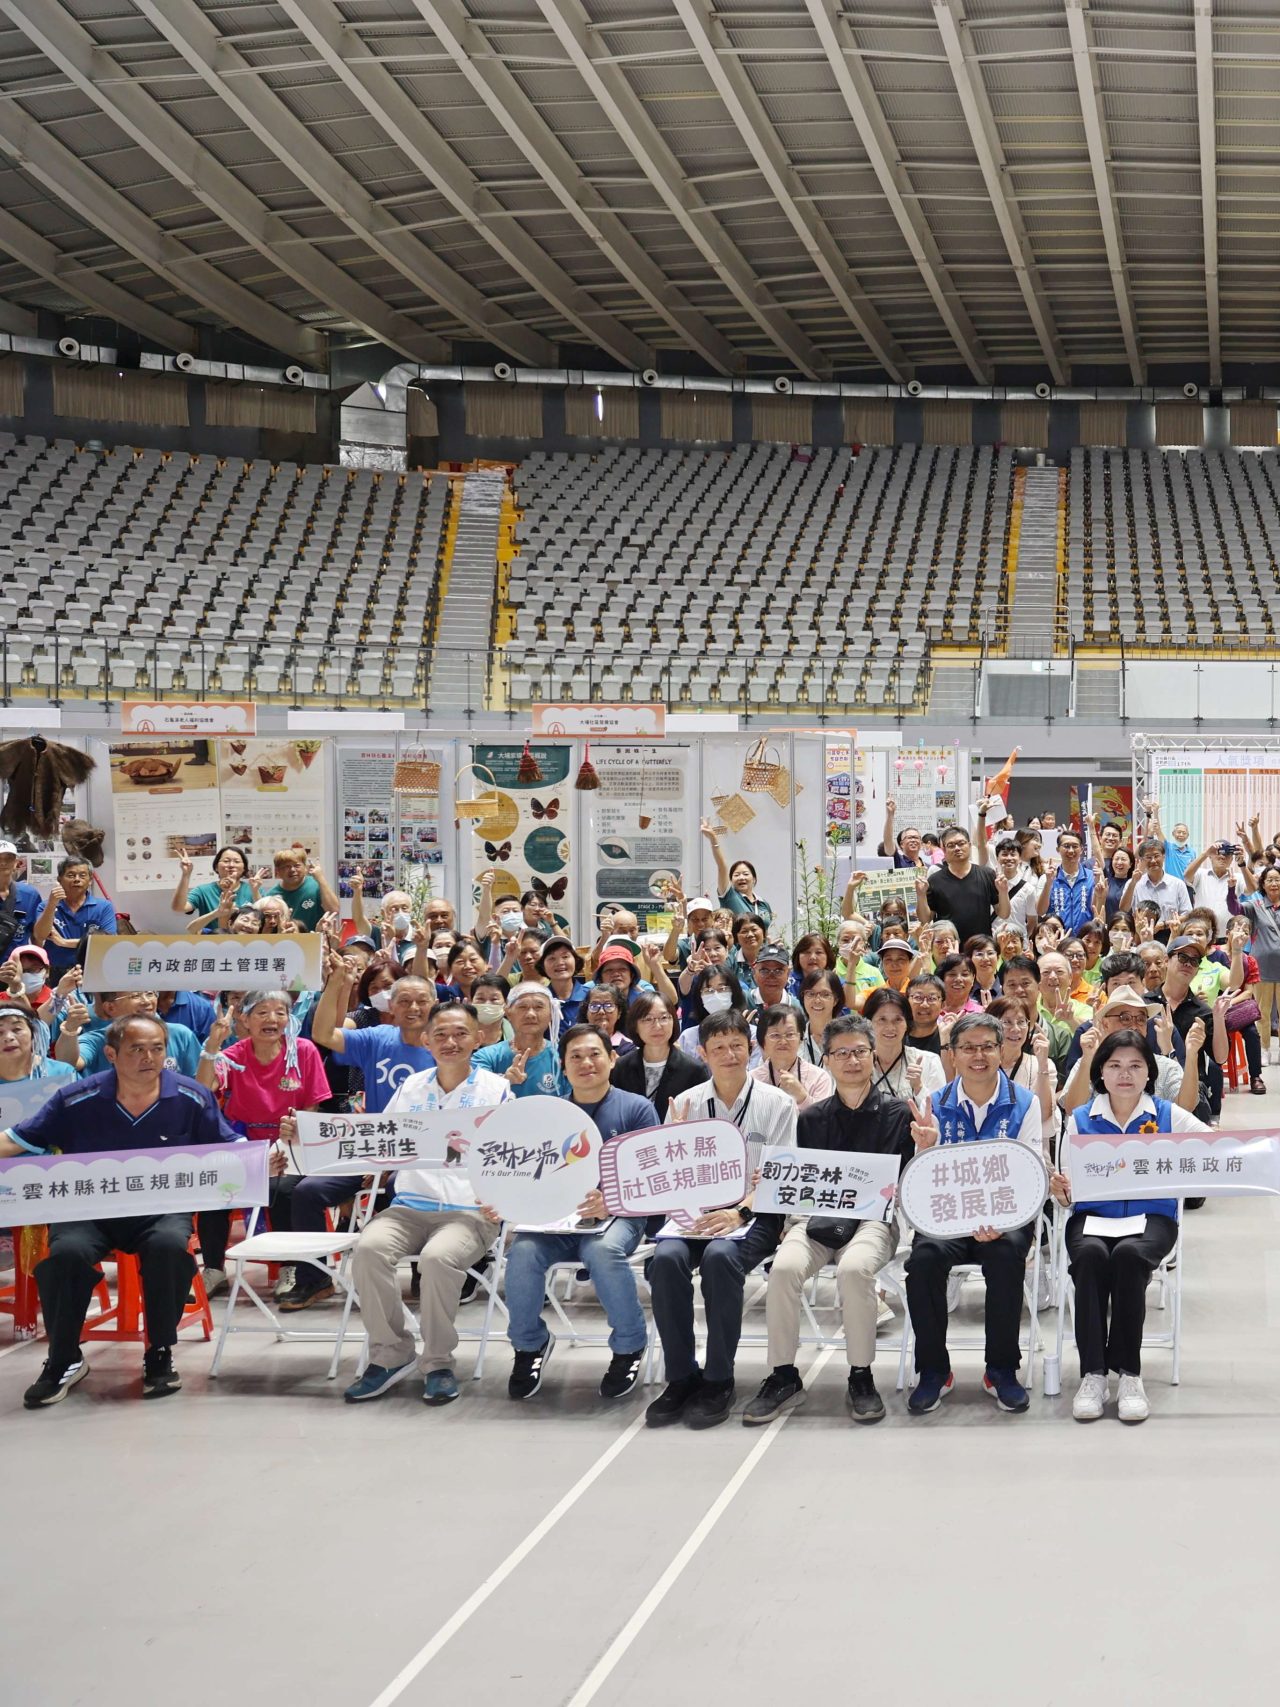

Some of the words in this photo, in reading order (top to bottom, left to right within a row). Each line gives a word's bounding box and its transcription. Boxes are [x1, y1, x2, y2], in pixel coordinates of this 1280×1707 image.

[142, 721, 150, 732] A
[552, 724, 560, 734] A
[148, 957, 287, 974] 內政部國土管理署
[318, 1119, 399, 1139] 韌力雲林
[337, 1138, 419, 1160] 厚土新生
[635, 1136, 718, 1171] 雲林縣
[762, 1161, 843, 1186] 韌力雲林
[931, 1153, 1011, 1188] #城鄉
[1132, 1156, 1244, 1174] 雲林縣政府
[22, 1170, 219, 1200] 雲林縣社區規劃師
[622, 1158, 743, 1202] 社區規劃師
[929, 1185, 1019, 1225] 發展處
